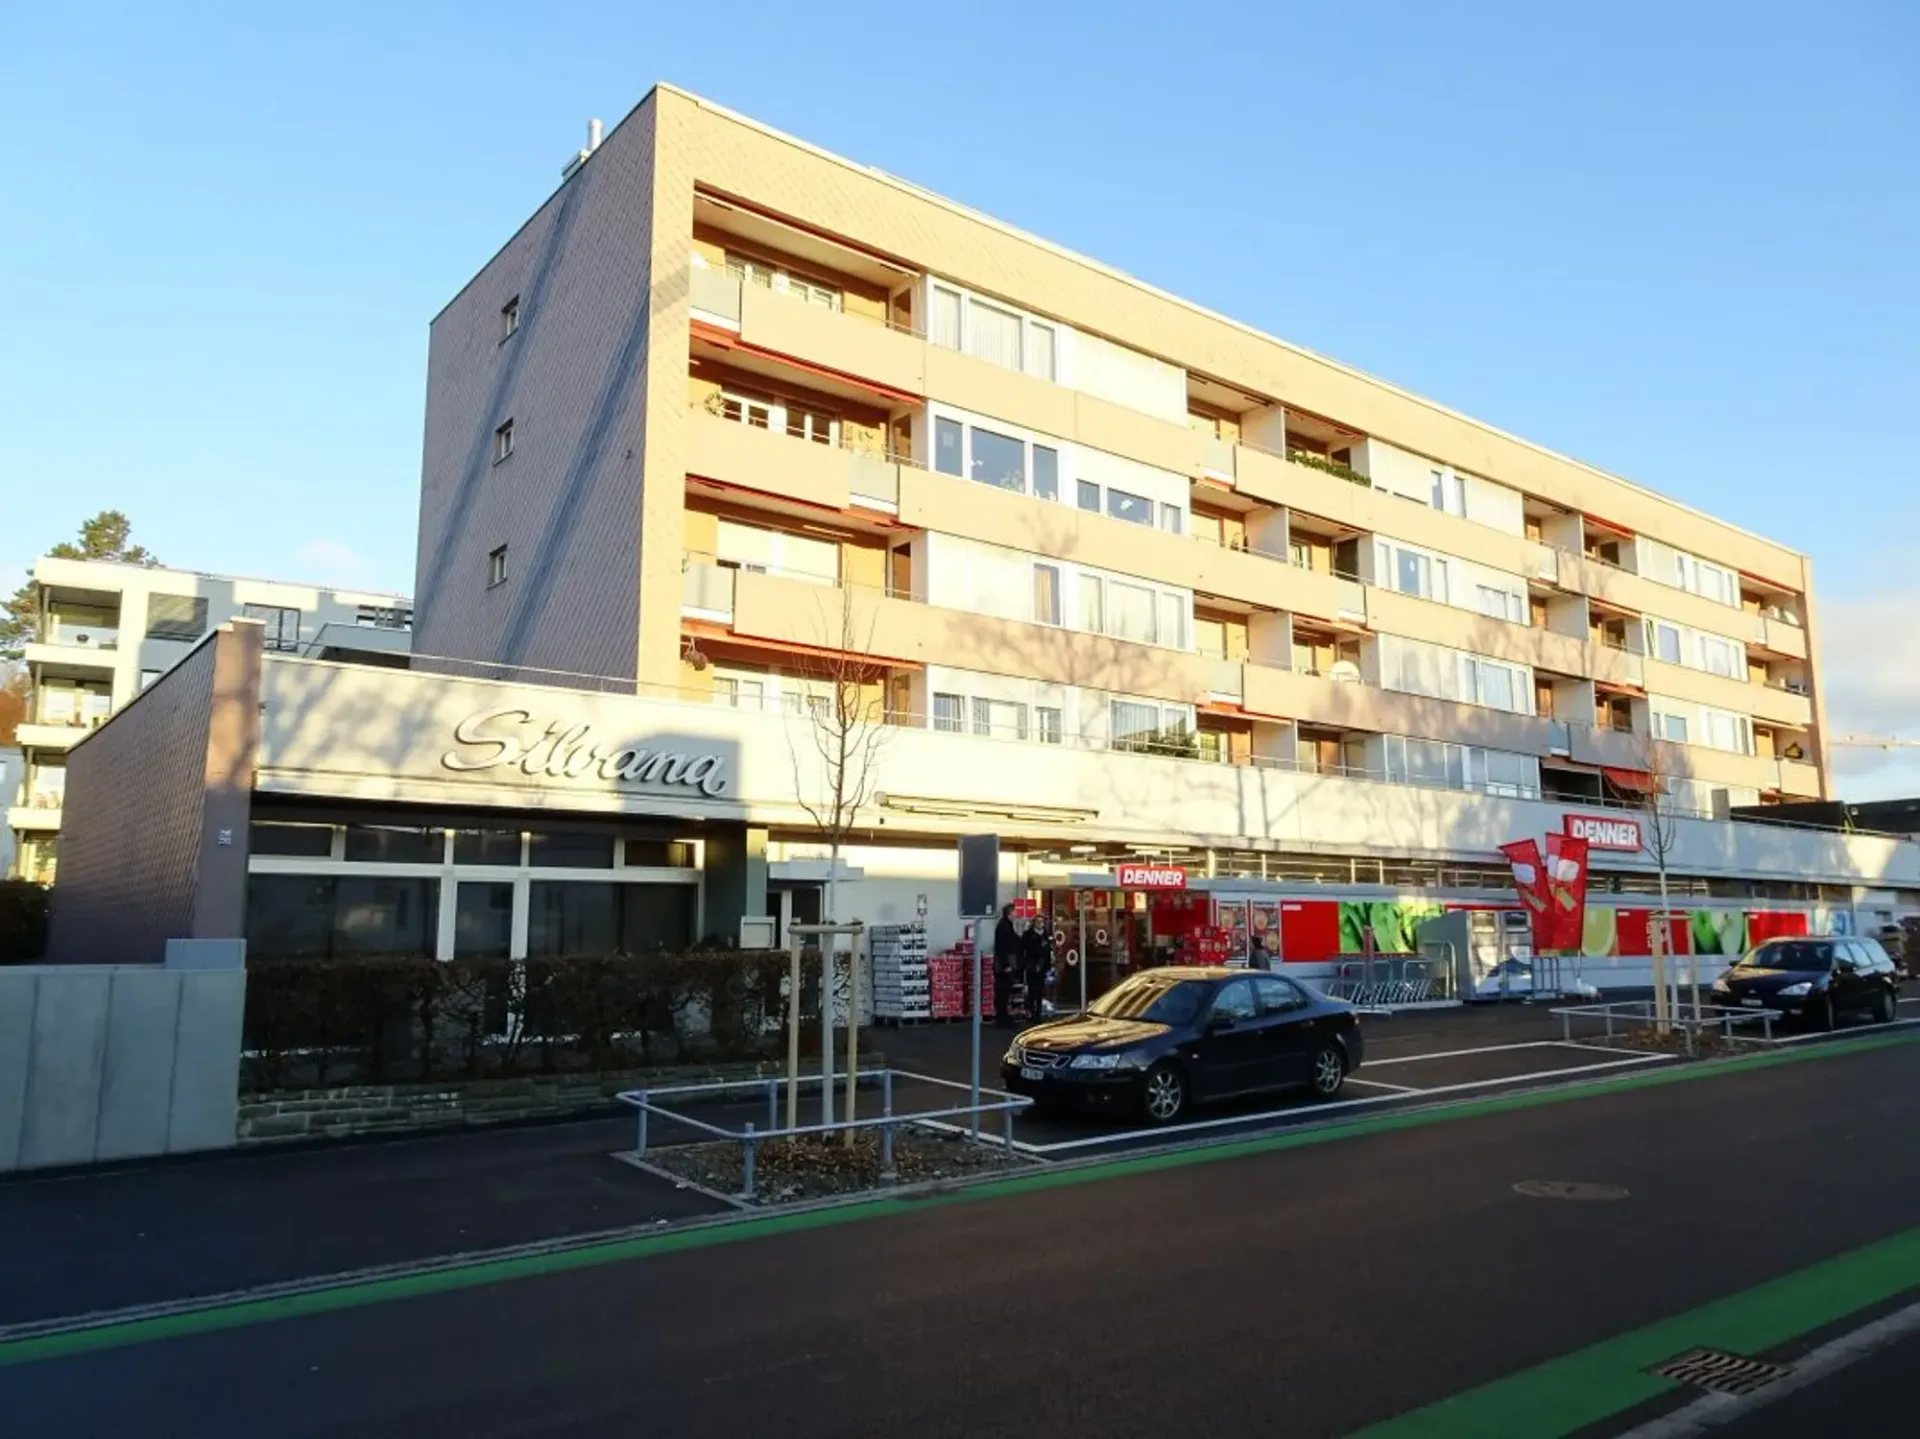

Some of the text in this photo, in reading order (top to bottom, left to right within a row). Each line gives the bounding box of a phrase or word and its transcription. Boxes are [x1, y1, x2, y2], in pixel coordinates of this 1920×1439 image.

[440, 709, 727, 797] Silvana
[1573, 819, 1637, 846] DENNER
[1122, 869, 1183, 886] DENNER
